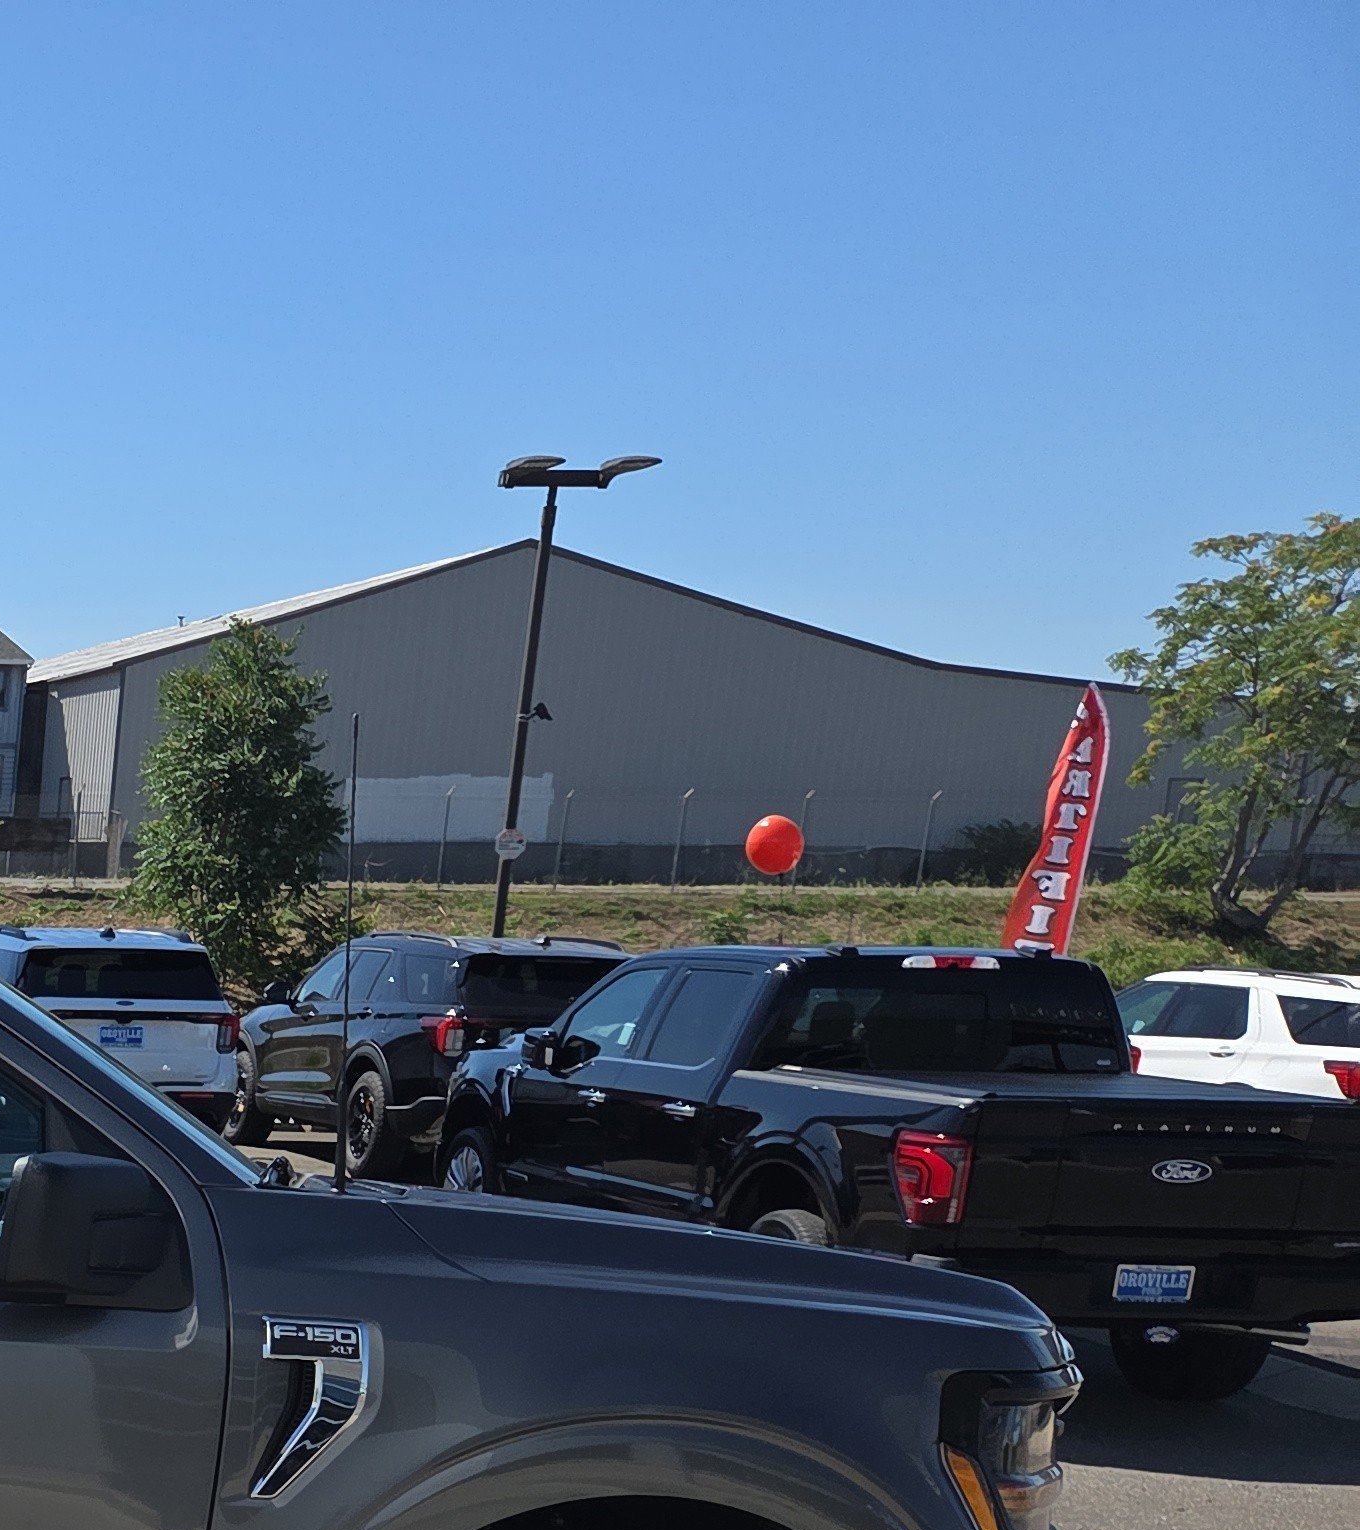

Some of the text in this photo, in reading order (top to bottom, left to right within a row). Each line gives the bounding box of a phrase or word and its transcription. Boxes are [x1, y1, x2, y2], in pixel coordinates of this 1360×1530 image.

[1112, 1122, 1281, 1134] PLATINUM
[1160, 1161, 1202, 1180] Ford
[1119, 1271, 1189, 1289] OROVILLE
[273, 1324, 357, 1345] F-150
[330, 1344, 355, 1355] XLT
